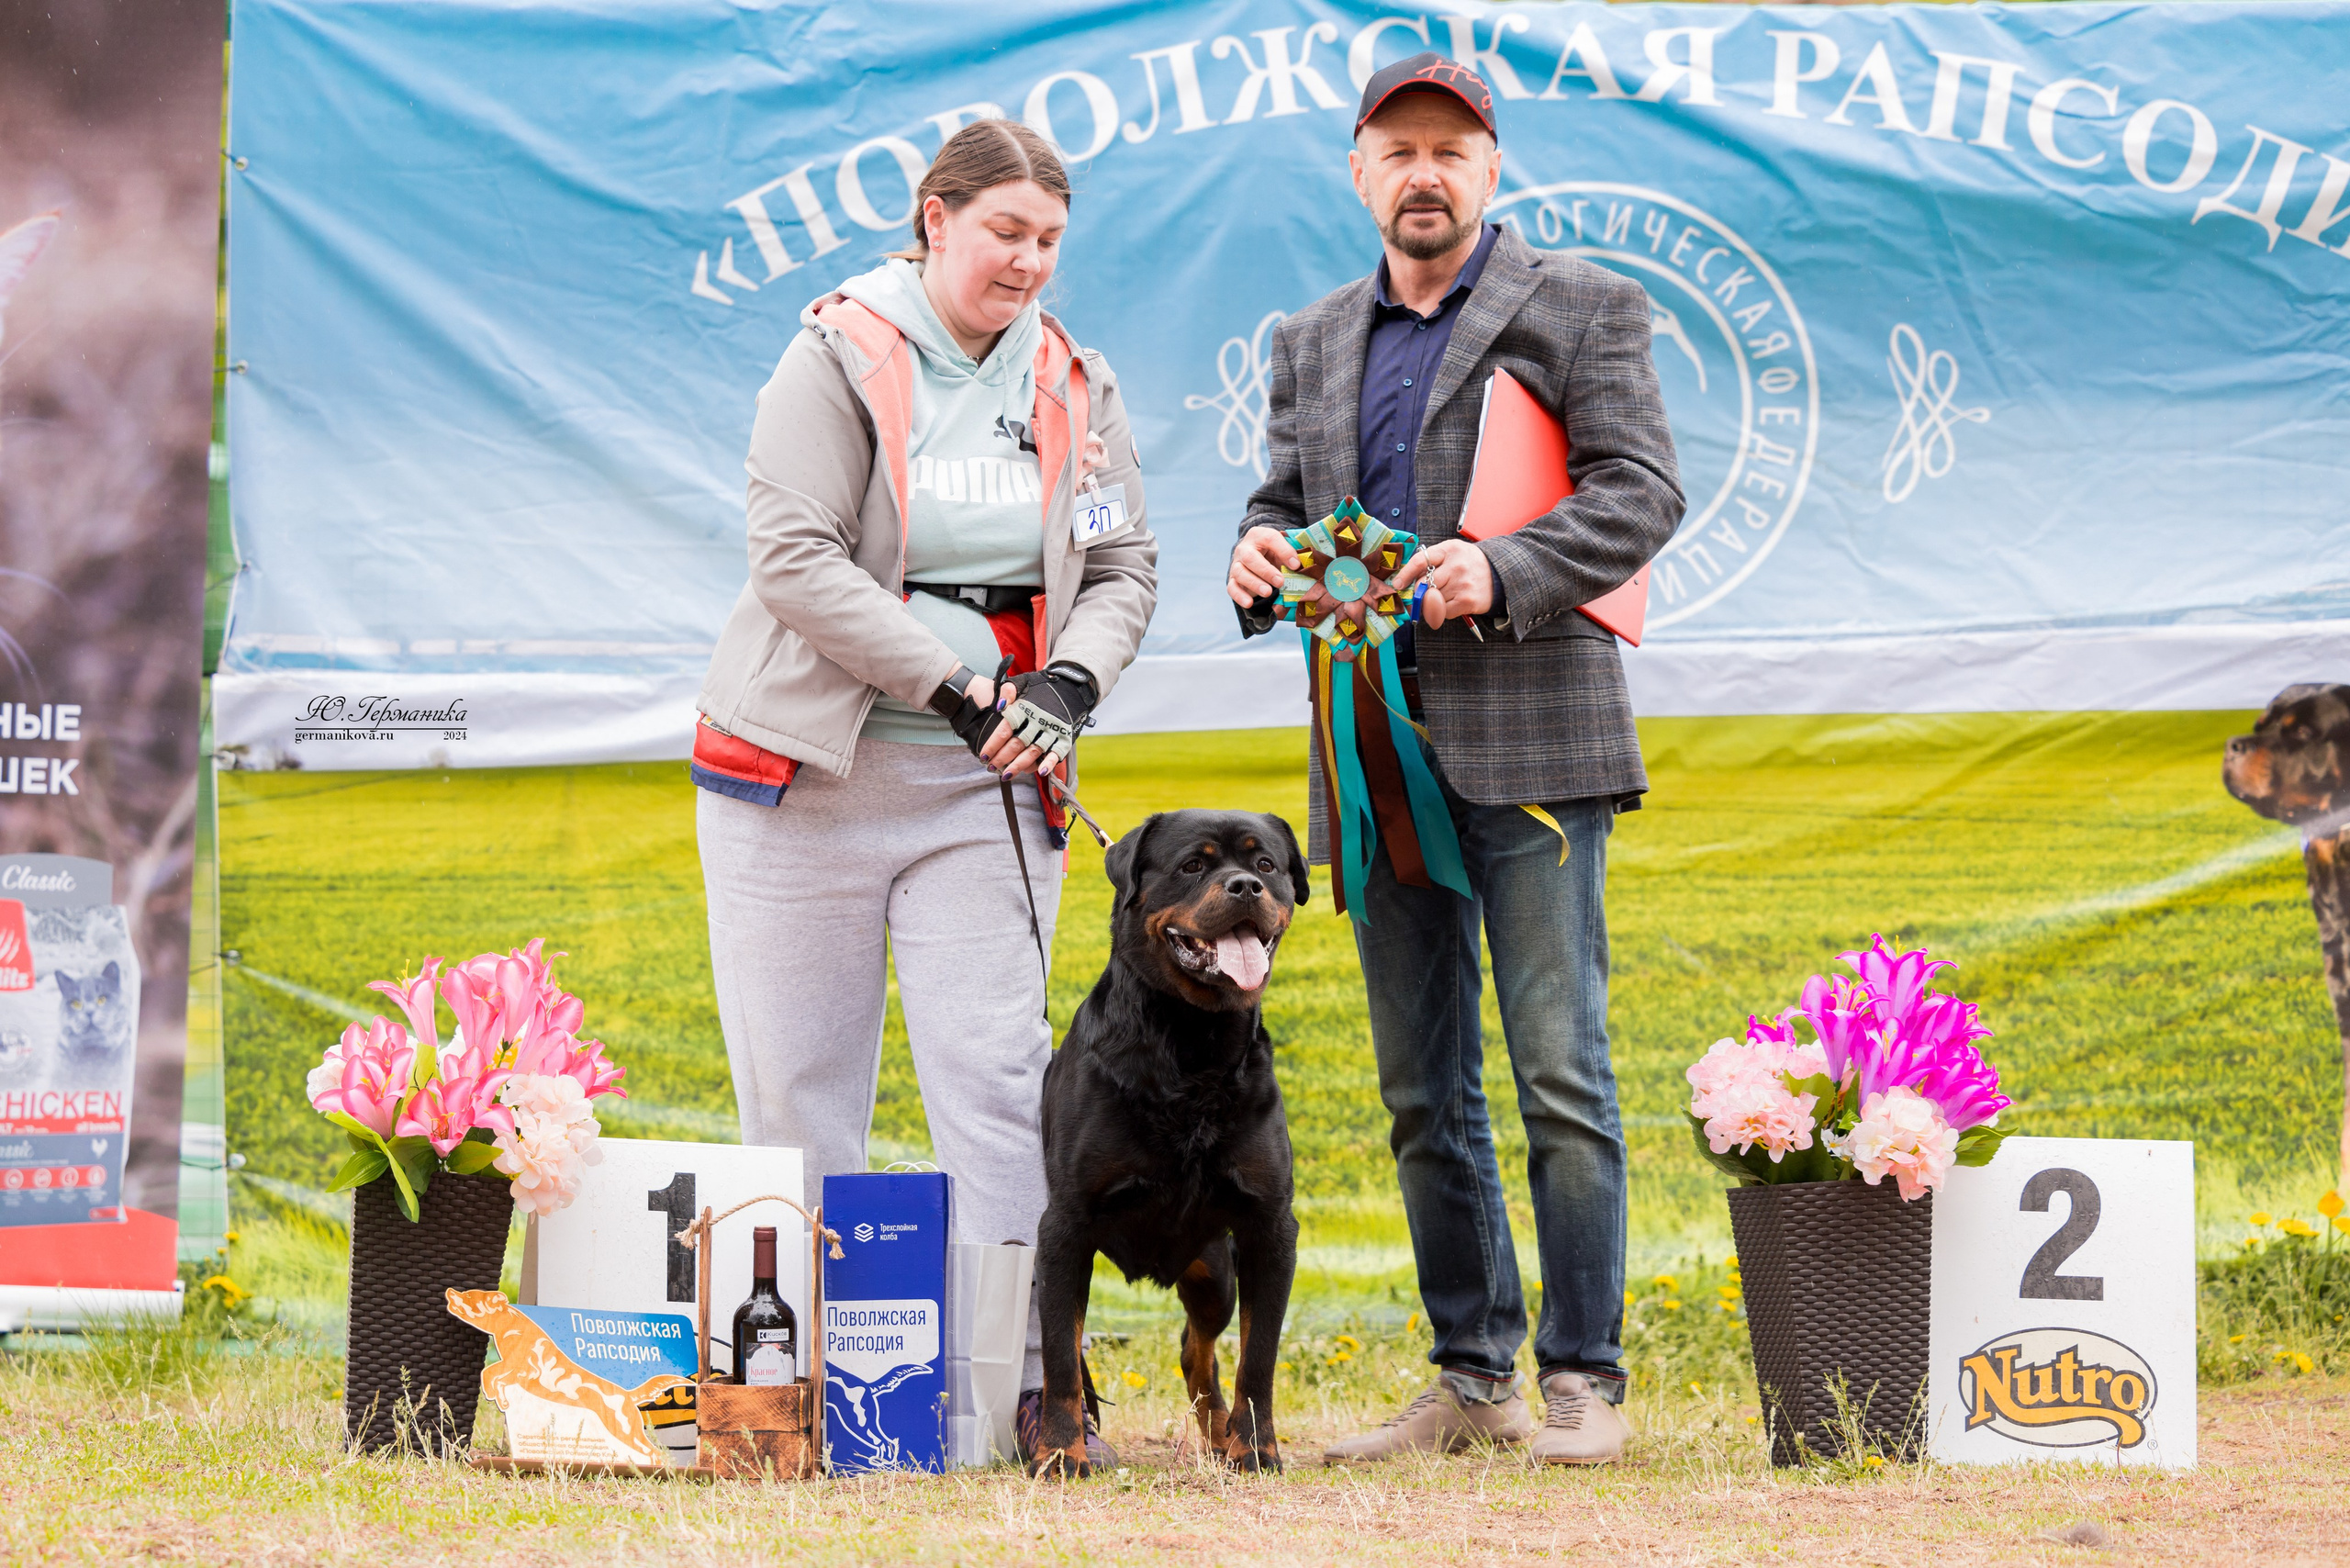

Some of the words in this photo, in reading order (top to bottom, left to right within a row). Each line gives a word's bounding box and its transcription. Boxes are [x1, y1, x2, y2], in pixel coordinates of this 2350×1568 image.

[690, 12, 1725, 305] «ПООЛЖСКАЯ
[907, 454, 1043, 504] PUMA
[1647, 365, 1801, 613] ФЕДЕРАЦИ
[1018, 702, 1036, 720] GEL
[1038, 717, 1072, 736] SHOCK
[2, 865, 77, 892] Classic
[0, 1091, 122, 1118] HICKEN
[647, 1171, 696, 1303] 1
[879, 1223, 918, 1233] Трехслойная
[879, 1233, 898, 1241] колба
[2019, 1167, 2104, 1302] 2
[571, 1312, 682, 1339] Поволжская
[827, 1306, 926, 1327] Поволжская
[575, 1337, 661, 1364] Рапсодия
[827, 1331, 904, 1354] Рапсодия
[750, 1365, 778, 1378] Красное
[1960, 1346, 2147, 1438] Nutro
